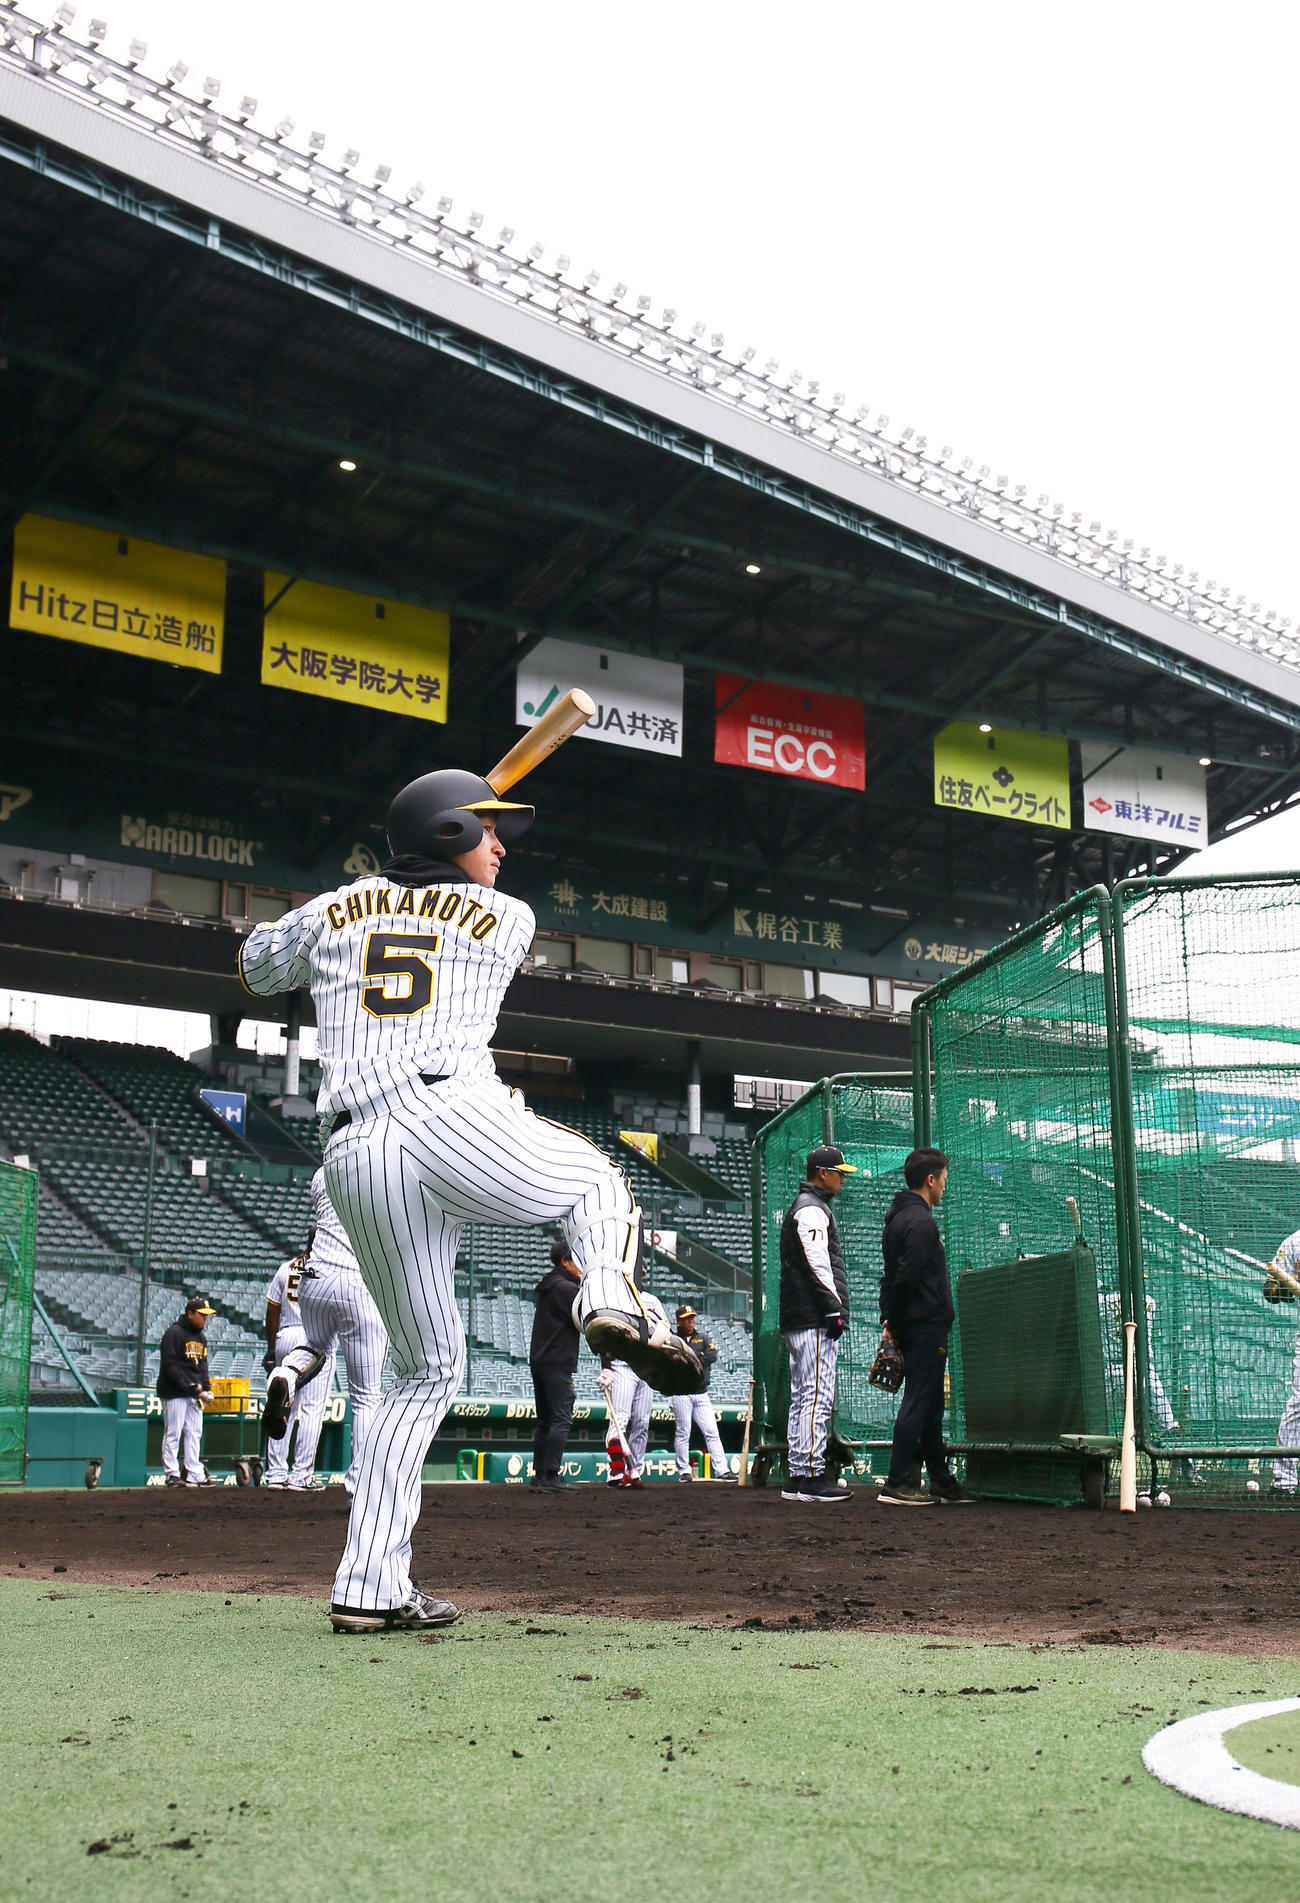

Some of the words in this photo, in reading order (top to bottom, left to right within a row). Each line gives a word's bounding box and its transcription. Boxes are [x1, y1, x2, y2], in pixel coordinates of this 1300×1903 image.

[18, 581, 216, 655] Hitz日立造船
[269, 642, 442, 704] 大阪学院大学
[585, 704, 679, 745] JA共済
[746, 726, 837, 779] ECC
[939, 774, 1067, 824] 住友ベークライト
[1114, 800, 1202, 833] 東洋アルミ
[120, 813, 255, 867] HARDLOCK
[326, 887, 498, 942] CHIKAMOTO
[591, 890, 669, 923] 大成建設
[755, 911, 843, 951] 梶谷工業
[361, 932, 440, 1019] 5
[808, 1228, 824, 1241] 77
